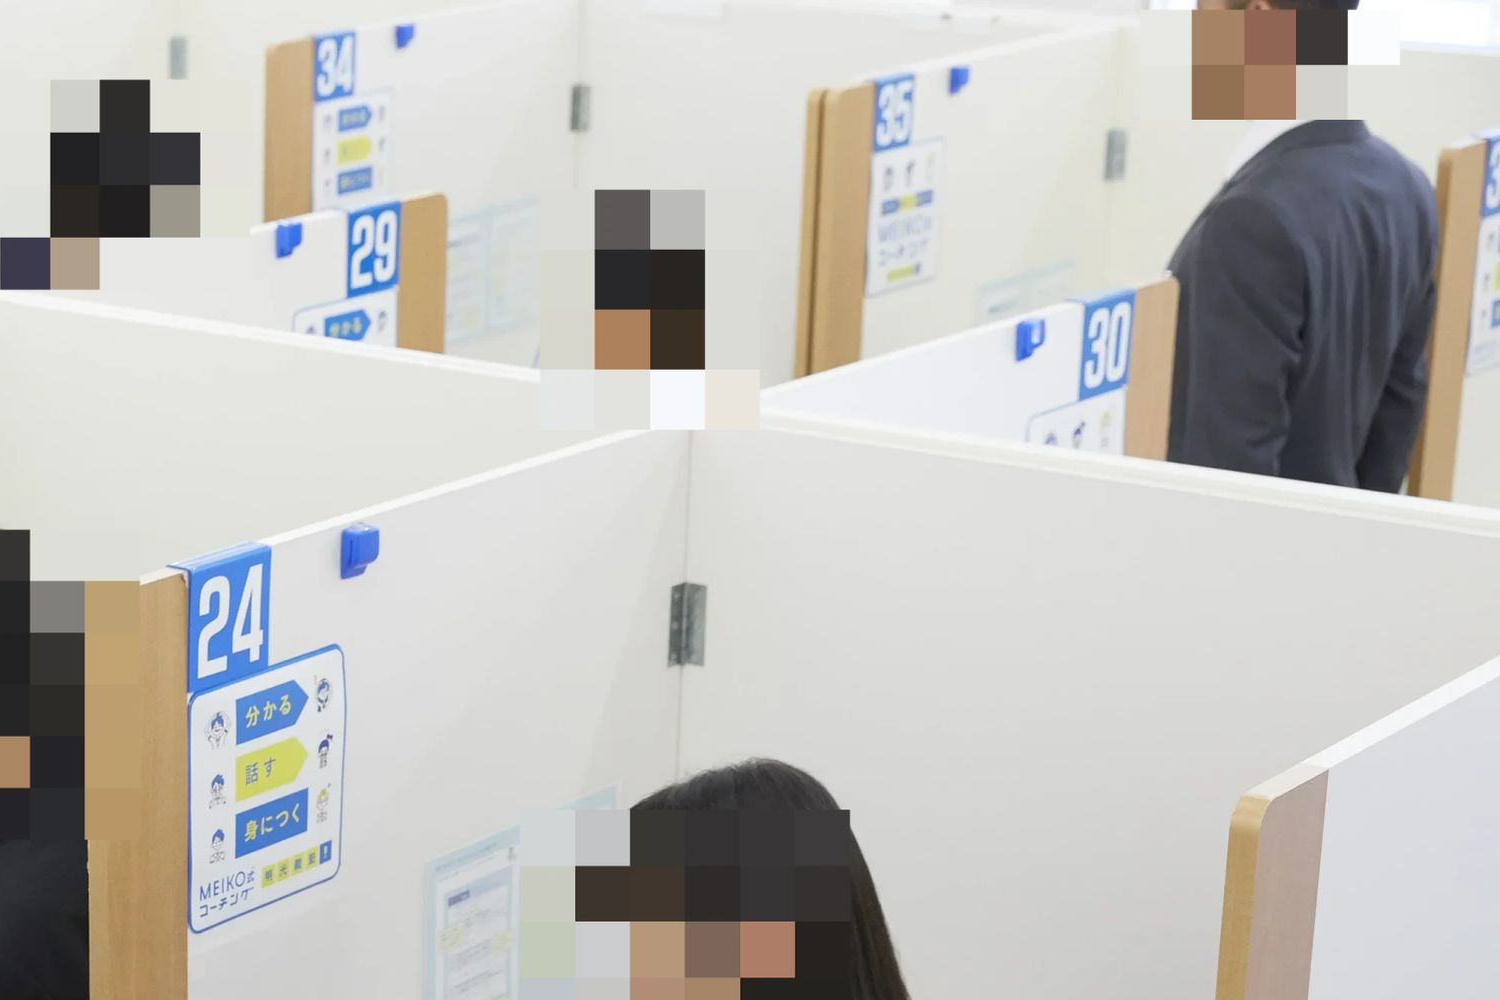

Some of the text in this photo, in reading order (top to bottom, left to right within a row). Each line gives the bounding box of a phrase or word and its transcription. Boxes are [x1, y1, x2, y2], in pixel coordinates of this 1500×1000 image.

[316, 34, 353, 97] 34
[876, 80, 913, 148] 35
[350, 209, 398, 290] 29
[1083, 301, 1132, 390] 30
[197, 563, 264, 679] 24
[245, 694, 292, 728] 分かる
[245, 757, 277, 785] 話す
[244, 803, 300, 842] 身につく
[199, 866, 255, 901] MEIKO式
[199, 886, 255, 918] コーチング
